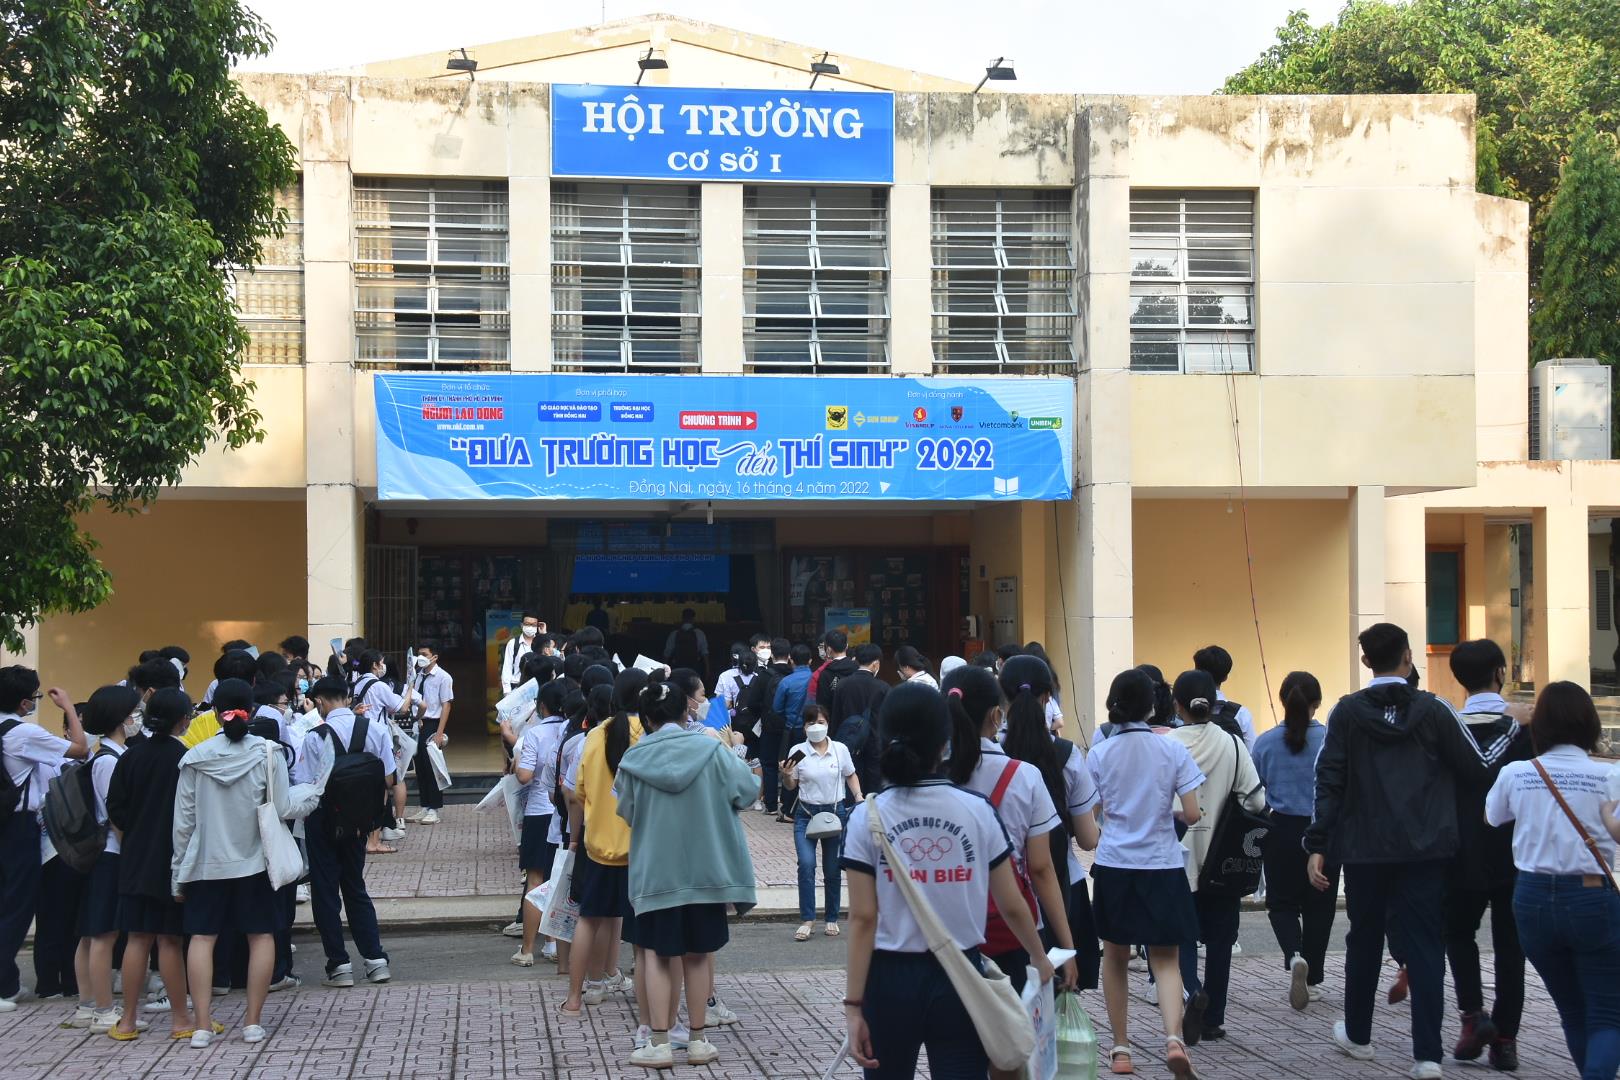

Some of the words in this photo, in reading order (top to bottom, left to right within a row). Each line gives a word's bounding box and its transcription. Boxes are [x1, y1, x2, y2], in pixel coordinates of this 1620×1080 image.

[582, 94, 664, 141] HỘI
[679, 97, 864, 139] TRƯỜNG
[667, 149, 710, 171] CƠ
[719, 146, 759, 173] SỞ
[769, 154, 782, 173] I
[455, 407, 474, 420] LAO
[682, 413, 716, 427] CHƯƠNG
[718, 412, 742, 427] TRÌNH
[979, 420, 1024, 429] Vietcombank
[540, 432, 655, 477] TRƯỜNG
[661, 437, 720, 471] HỌC
[735, 441, 778, 477] đến
[778, 433, 824, 478] THÍ
[915, 439, 994, 470] 2022
[629, 478, 666, 499] Đồng
[669, 480, 692, 496] Nai,
[698, 481, 733, 498] ngày
[735, 481, 750, 495] 16
[752, 479, 794, 498] tháng
[795, 481, 804, 495] 4
[806, 480, 837, 495] năm
[840, 481, 870, 495] 2022
[891, 817, 920, 836] TRUNG
[922, 816, 941, 829] HỌC
[960, 834, 976, 863] THÔNG
